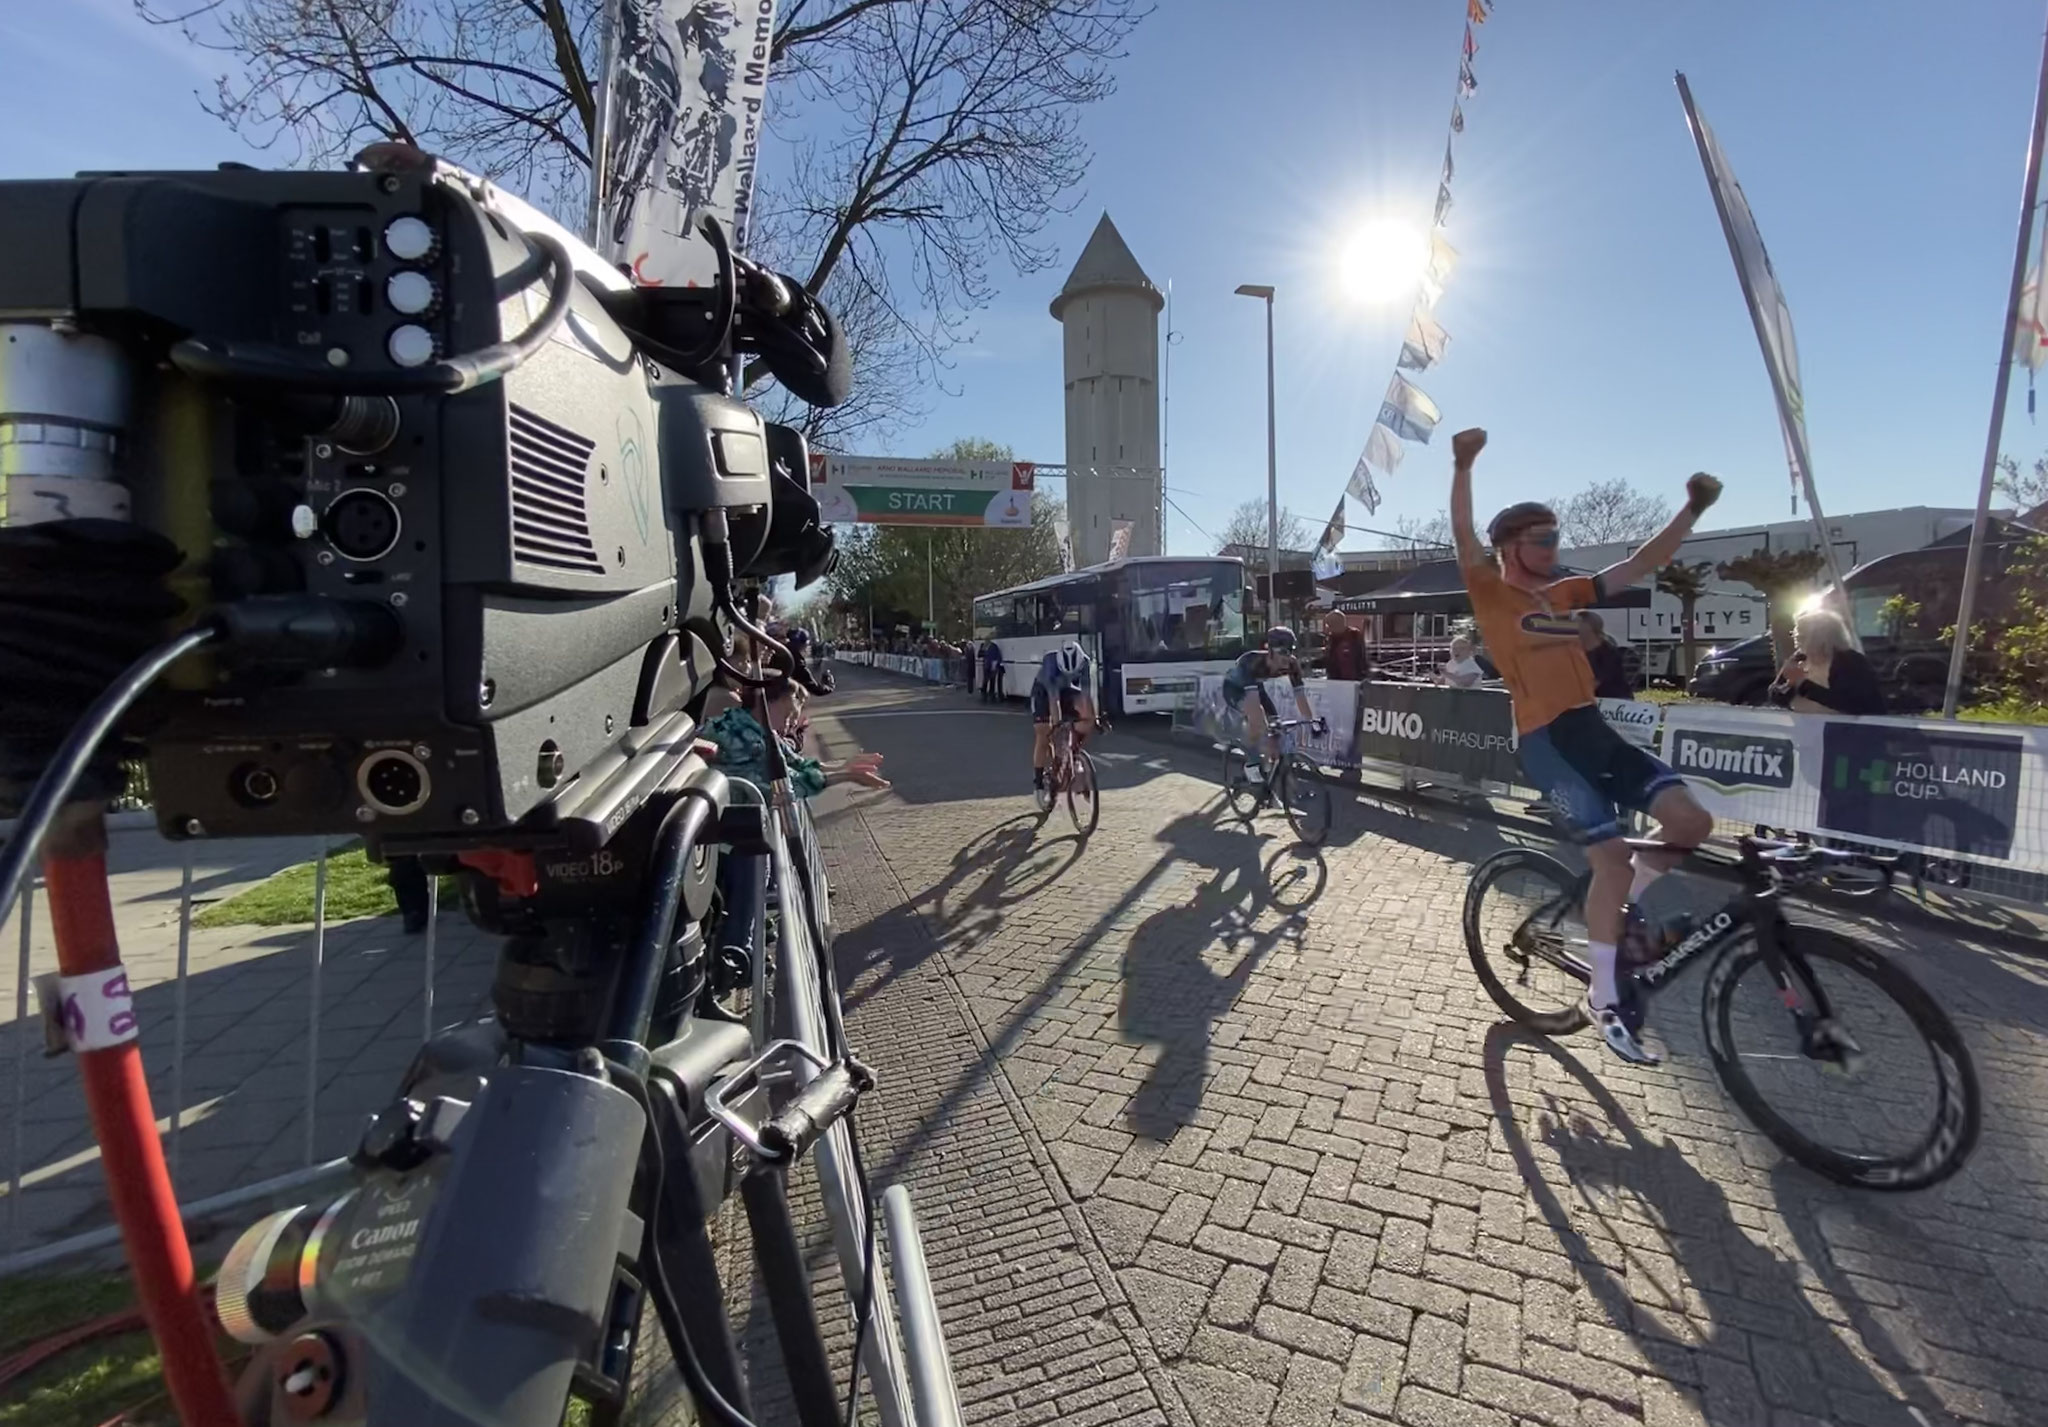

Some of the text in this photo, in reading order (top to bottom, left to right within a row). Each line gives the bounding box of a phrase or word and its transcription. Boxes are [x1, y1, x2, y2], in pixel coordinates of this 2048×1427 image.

[744, 0, 773, 86] Memo
[888, 492, 956, 511] START
[1680, 738, 1783, 778] Romfix
[1896, 761, 2006, 789] HOLLAND
[1645, 912, 1733, 985] PINARELLO
[351, 1219, 420, 1249] Canon
